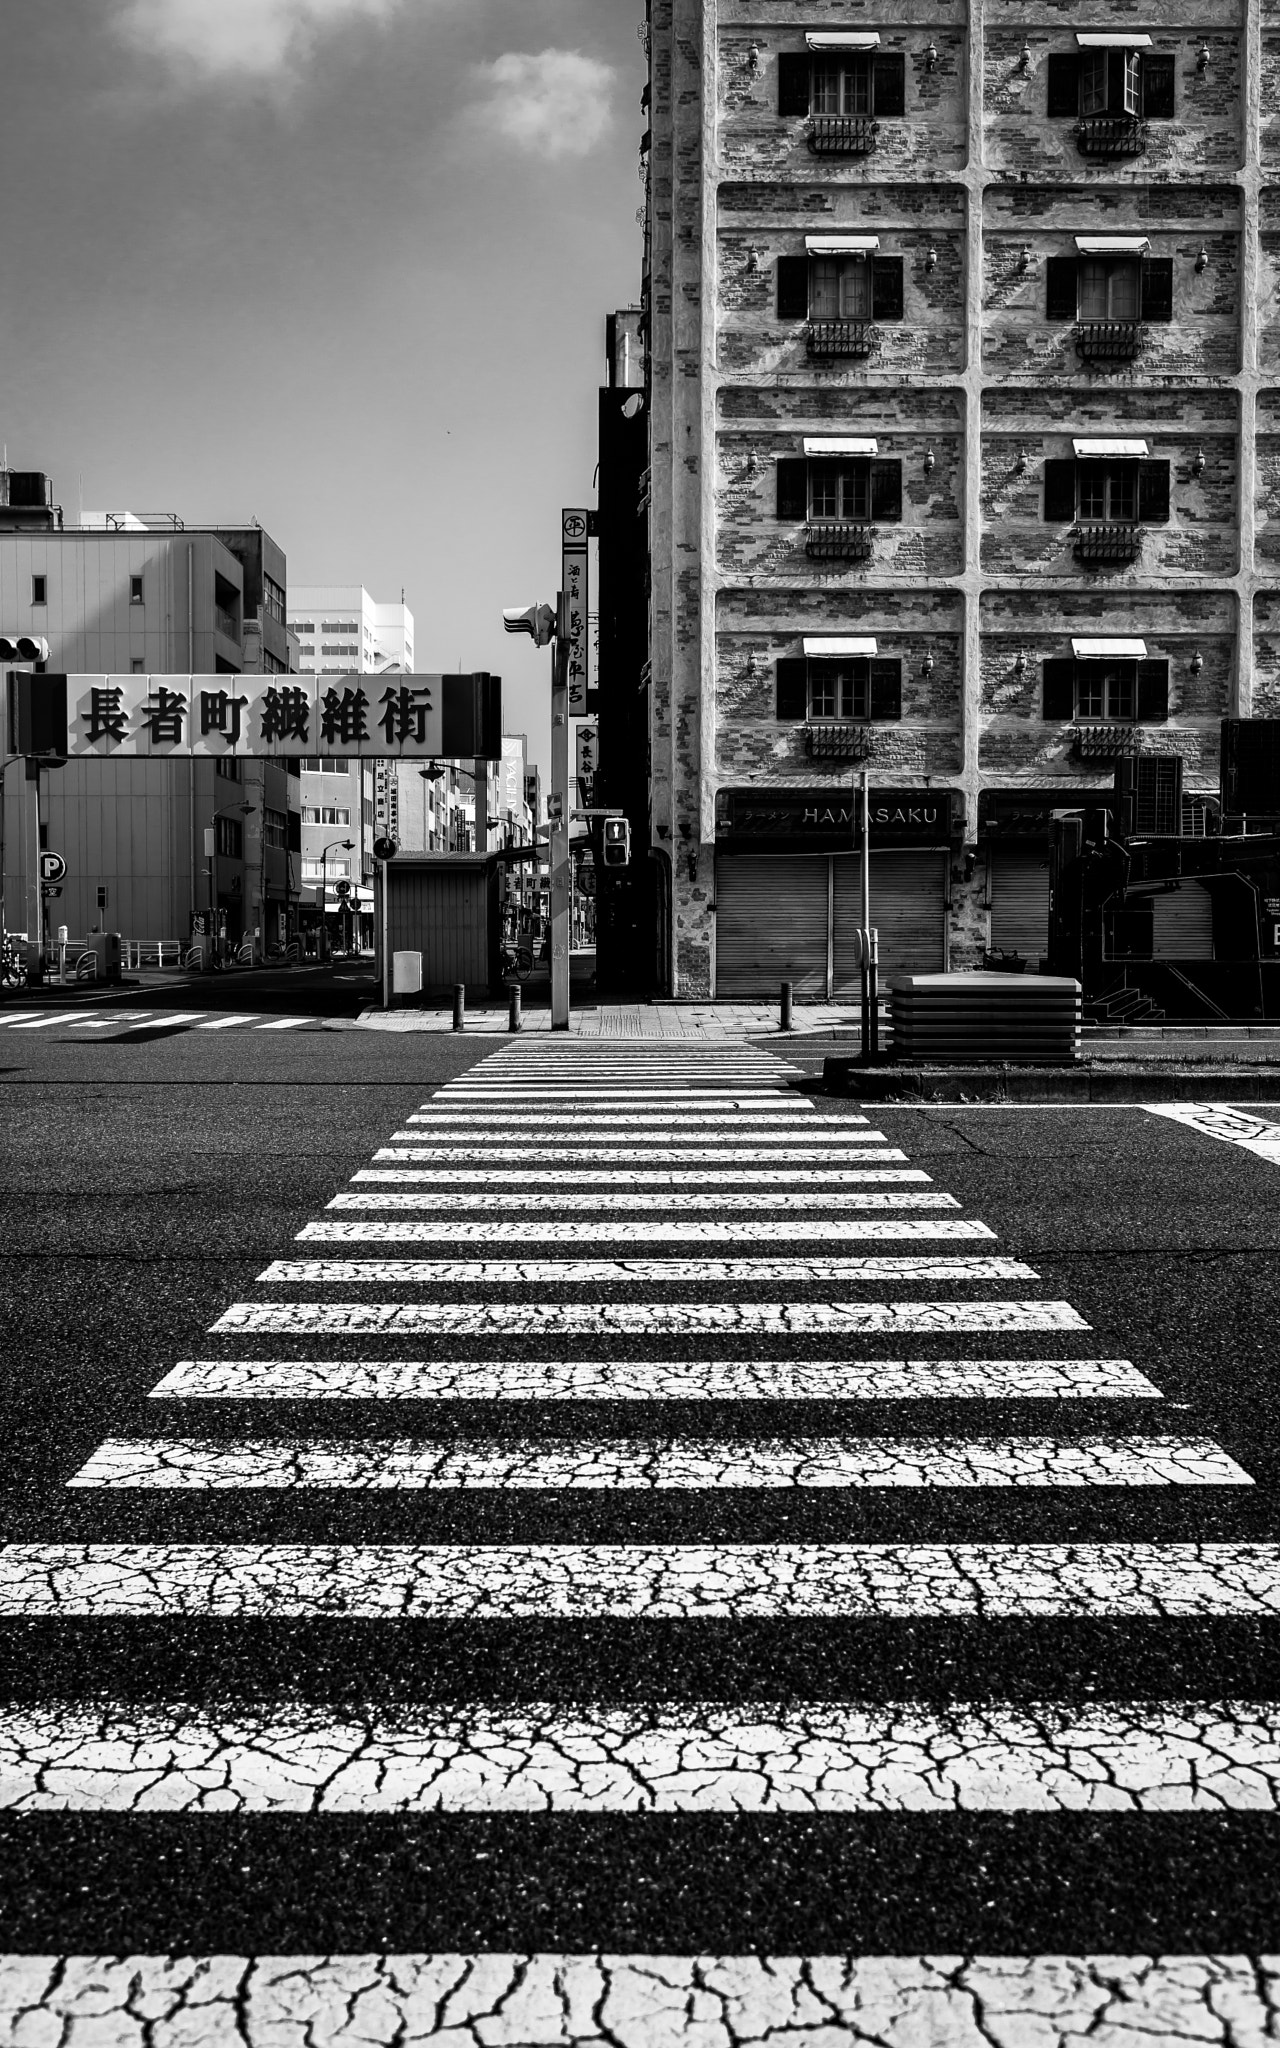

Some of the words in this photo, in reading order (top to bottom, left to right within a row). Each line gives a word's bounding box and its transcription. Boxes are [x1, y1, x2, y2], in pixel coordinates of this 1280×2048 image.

[744, 810, 790, 821] ラーメン
[1010, 811, 1044, 821] ラーメ
[44, 857, 60, 877] P
